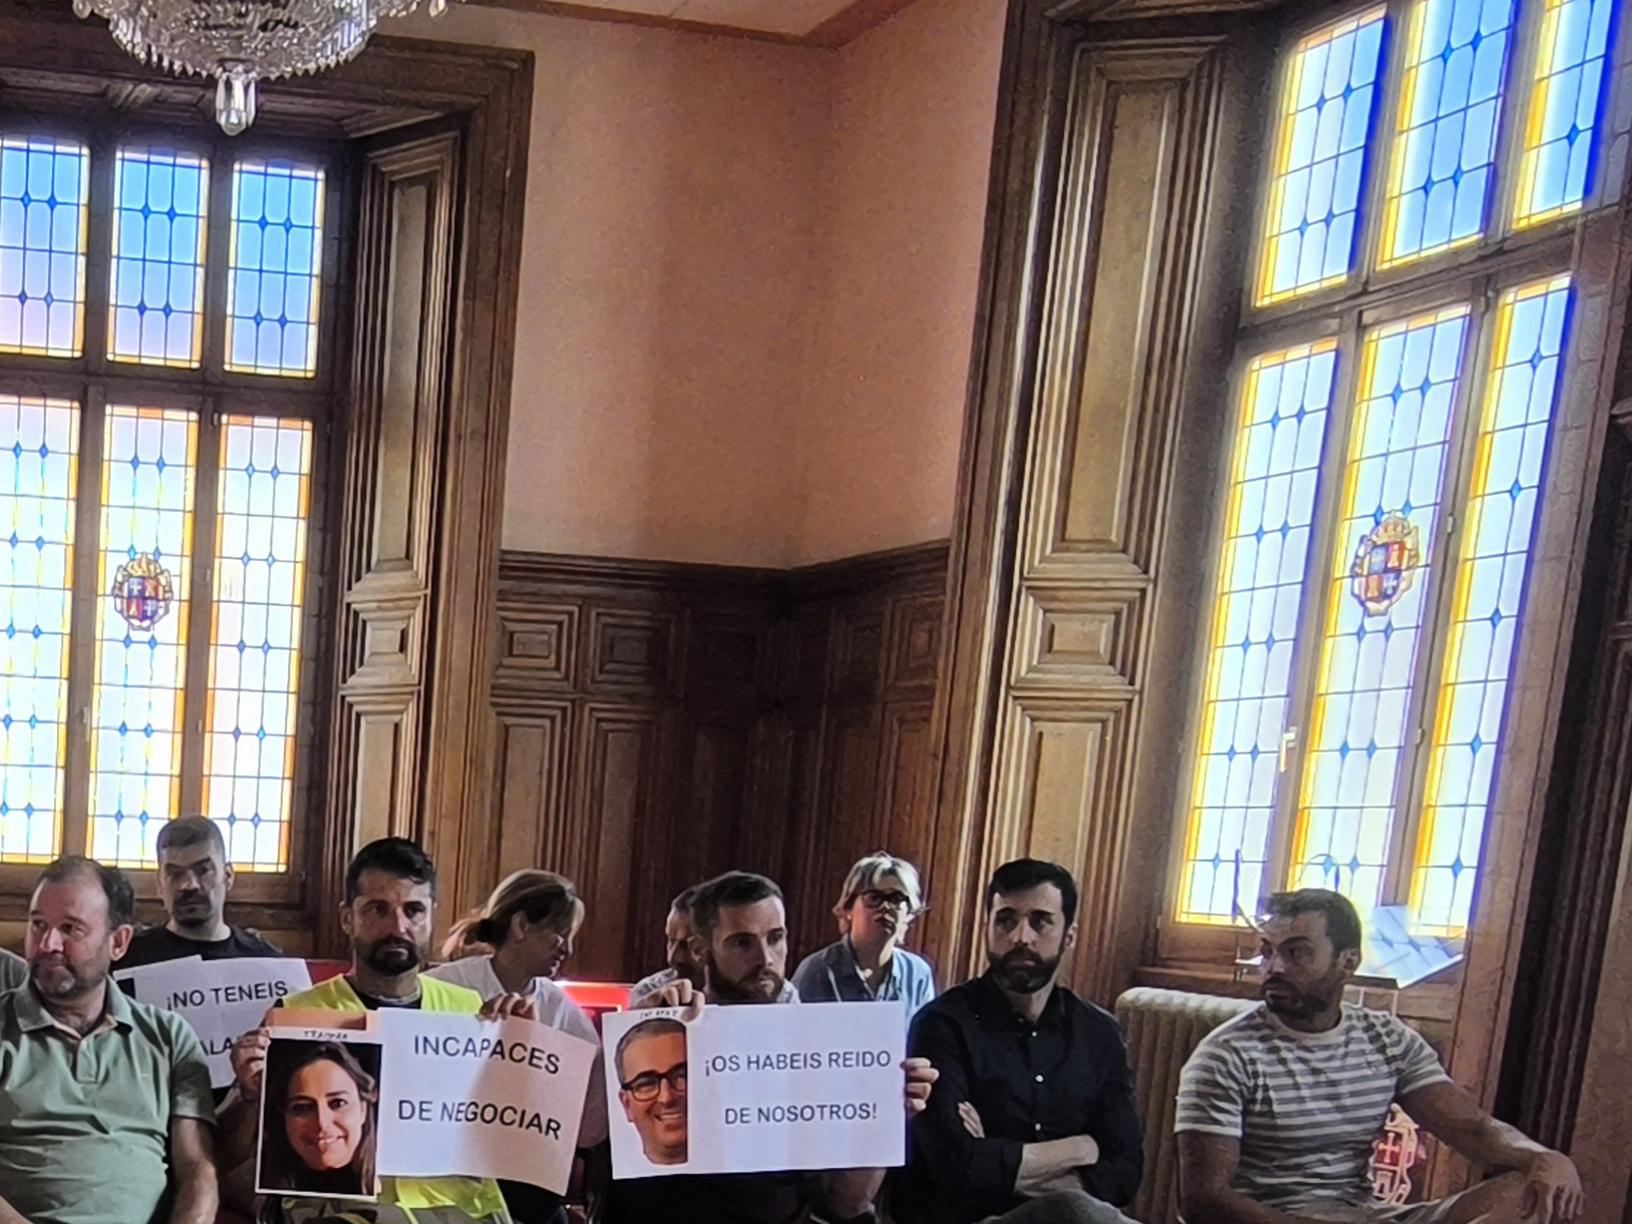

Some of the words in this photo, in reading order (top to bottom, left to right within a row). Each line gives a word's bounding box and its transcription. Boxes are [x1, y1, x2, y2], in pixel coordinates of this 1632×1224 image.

[210, 980, 288, 1002] TENEIS
[414, 1035, 560, 1075] INCAPACES
[704, 1054, 741, 1077] ¡OS
[746, 1052, 822, 1072] HABEIS
[828, 1049, 891, 1069] REIDO
[398, 1099, 433, 1122] DE
[440, 1101, 562, 1140] NEGOCIAR
[724, 1107, 751, 1125] DE
[757, 1102, 878, 1123] NOSOTROS!
